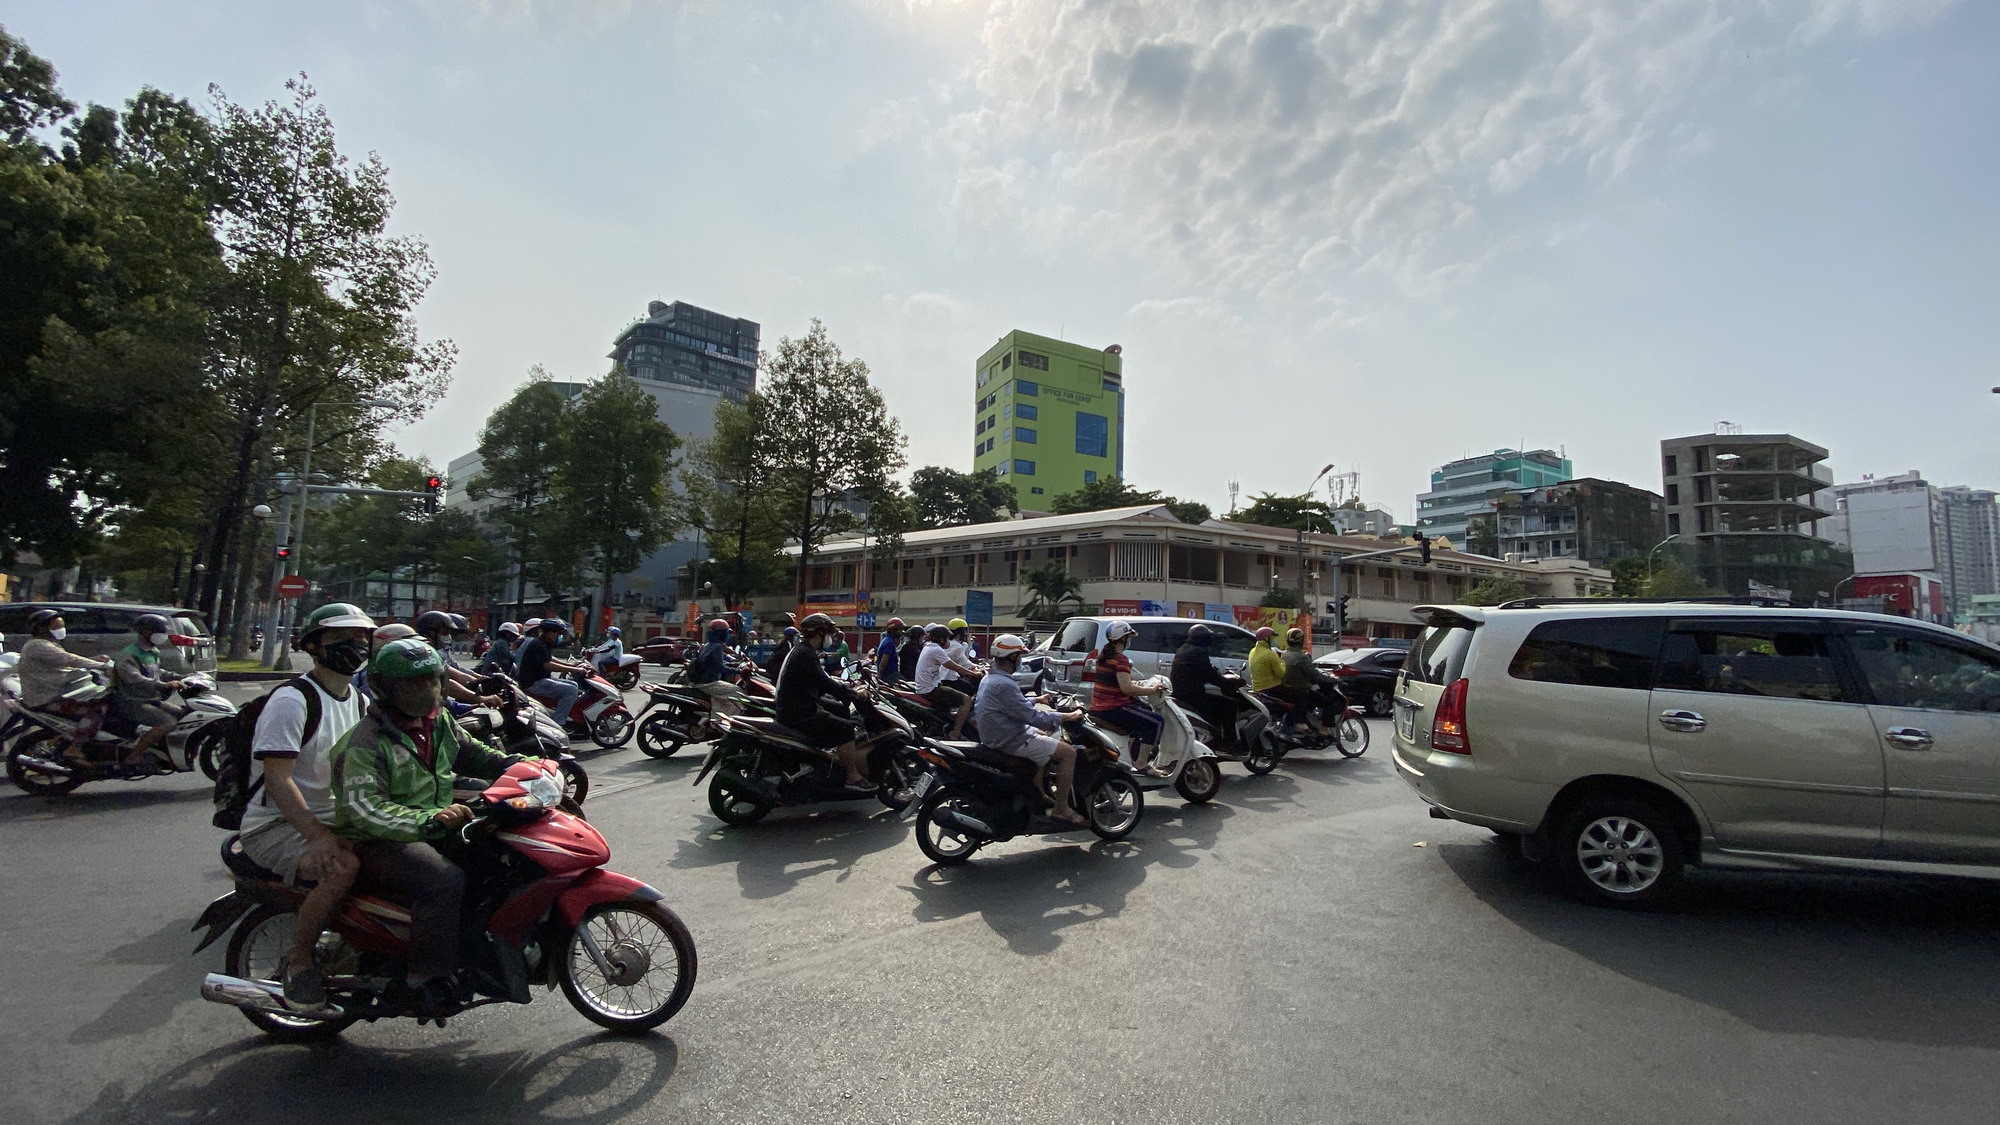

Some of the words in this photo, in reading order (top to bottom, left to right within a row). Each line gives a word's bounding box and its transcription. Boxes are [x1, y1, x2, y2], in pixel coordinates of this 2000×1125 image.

[1043, 387, 1061, 397] OFFICE
[1063, 391, 1074, 399] FOR
[1075, 394, 1091, 403] LEASE
[413, 656, 437, 669] Grab
